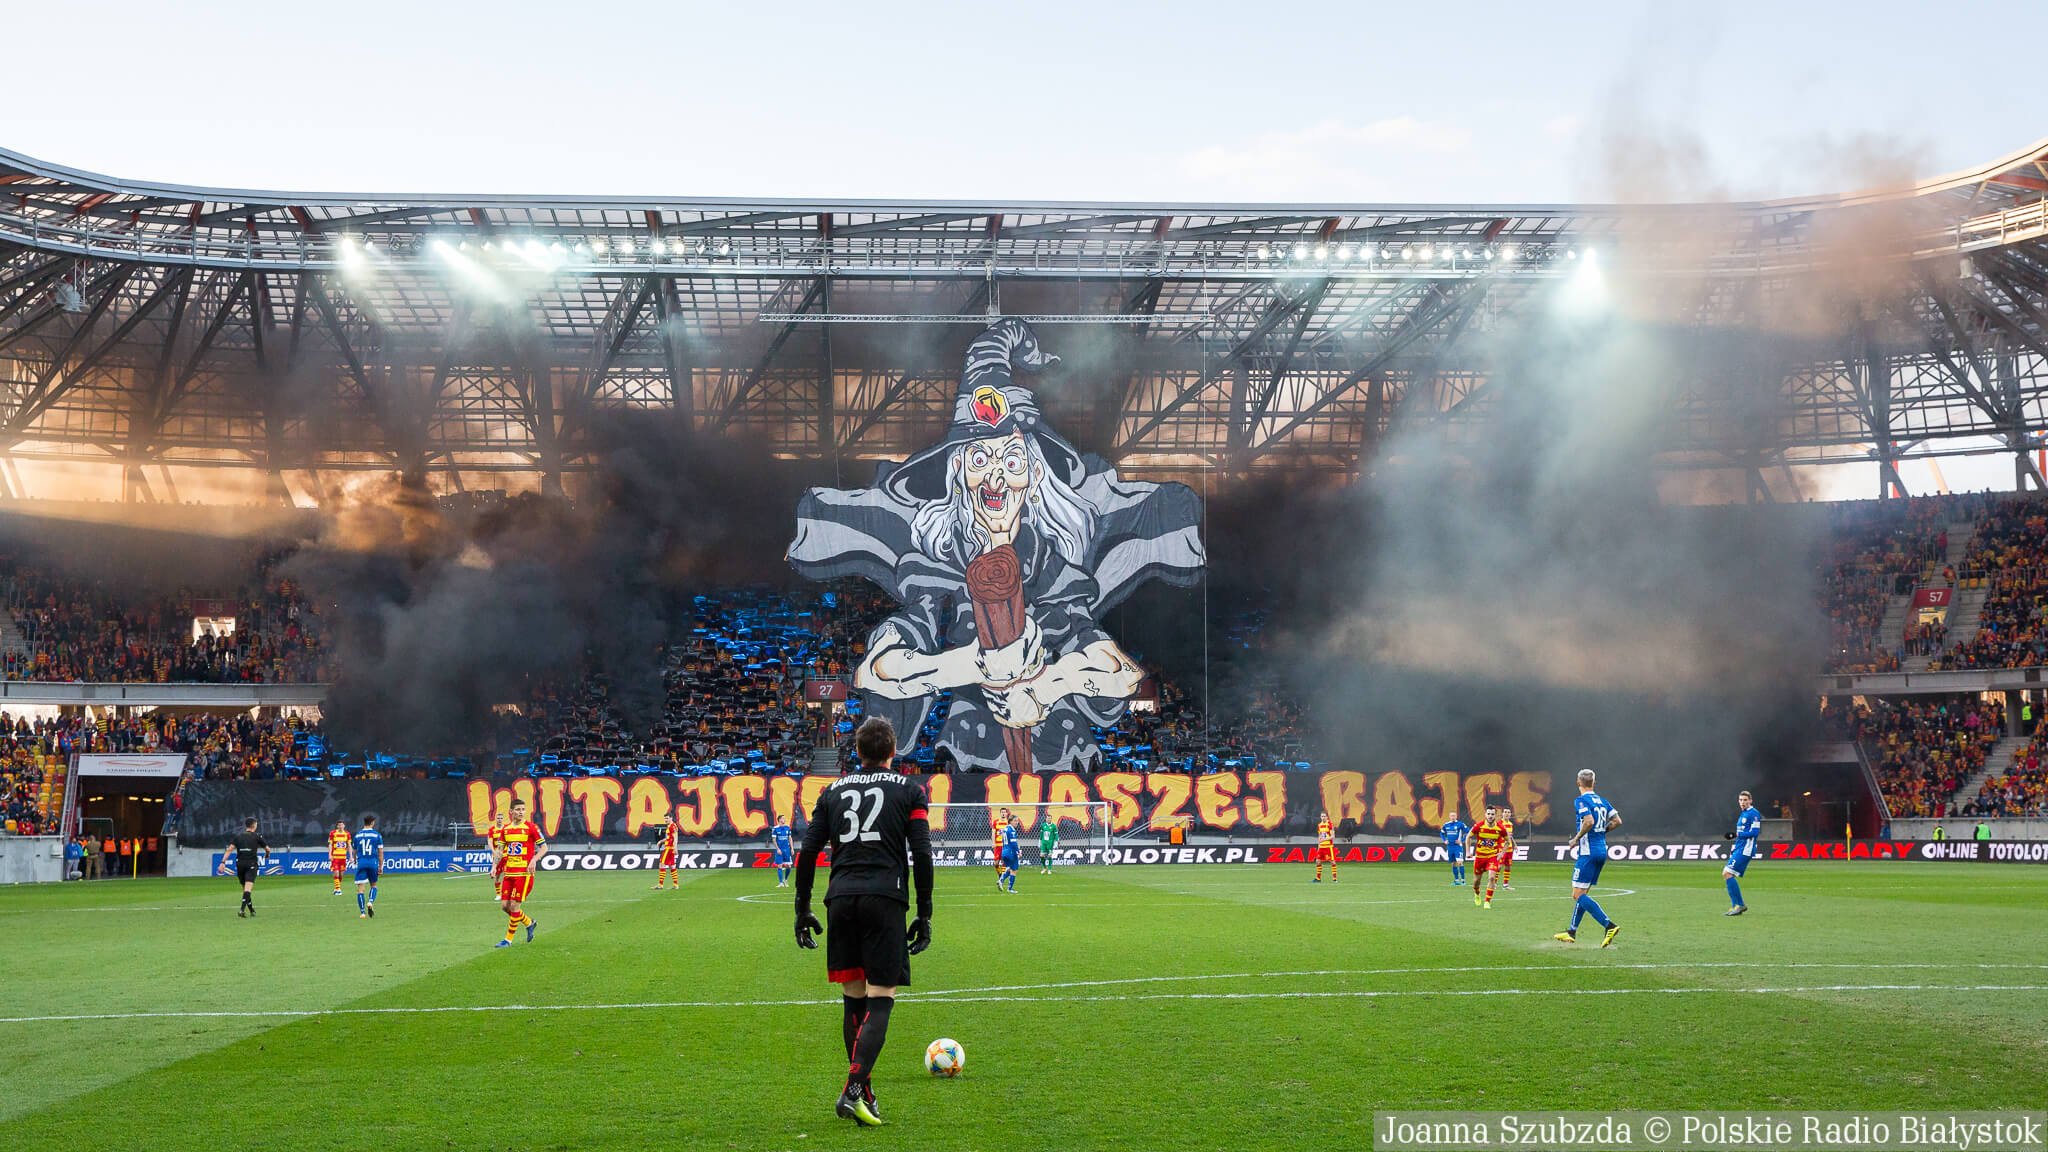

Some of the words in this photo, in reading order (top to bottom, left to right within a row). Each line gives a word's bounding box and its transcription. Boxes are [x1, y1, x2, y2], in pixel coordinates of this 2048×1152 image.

[1930, 591, 1943, 602] 57
[819, 684, 833, 697] 27
[984, 770, 1286, 833] NASZEJ
[839, 787, 885, 843] 32
[359, 838, 372, 856] 14
[507, 842, 523, 855] STS
[465, 853, 493, 864] PZPN
[540, 852, 744, 870] OTOLOTK.PL
[1770, 843, 1915, 859] ZAKŁADY
[1921, 842, 1979, 859] ON-LINE
[291, 859, 318, 873] Łączy
[1729, 859, 1736, 868] 3
